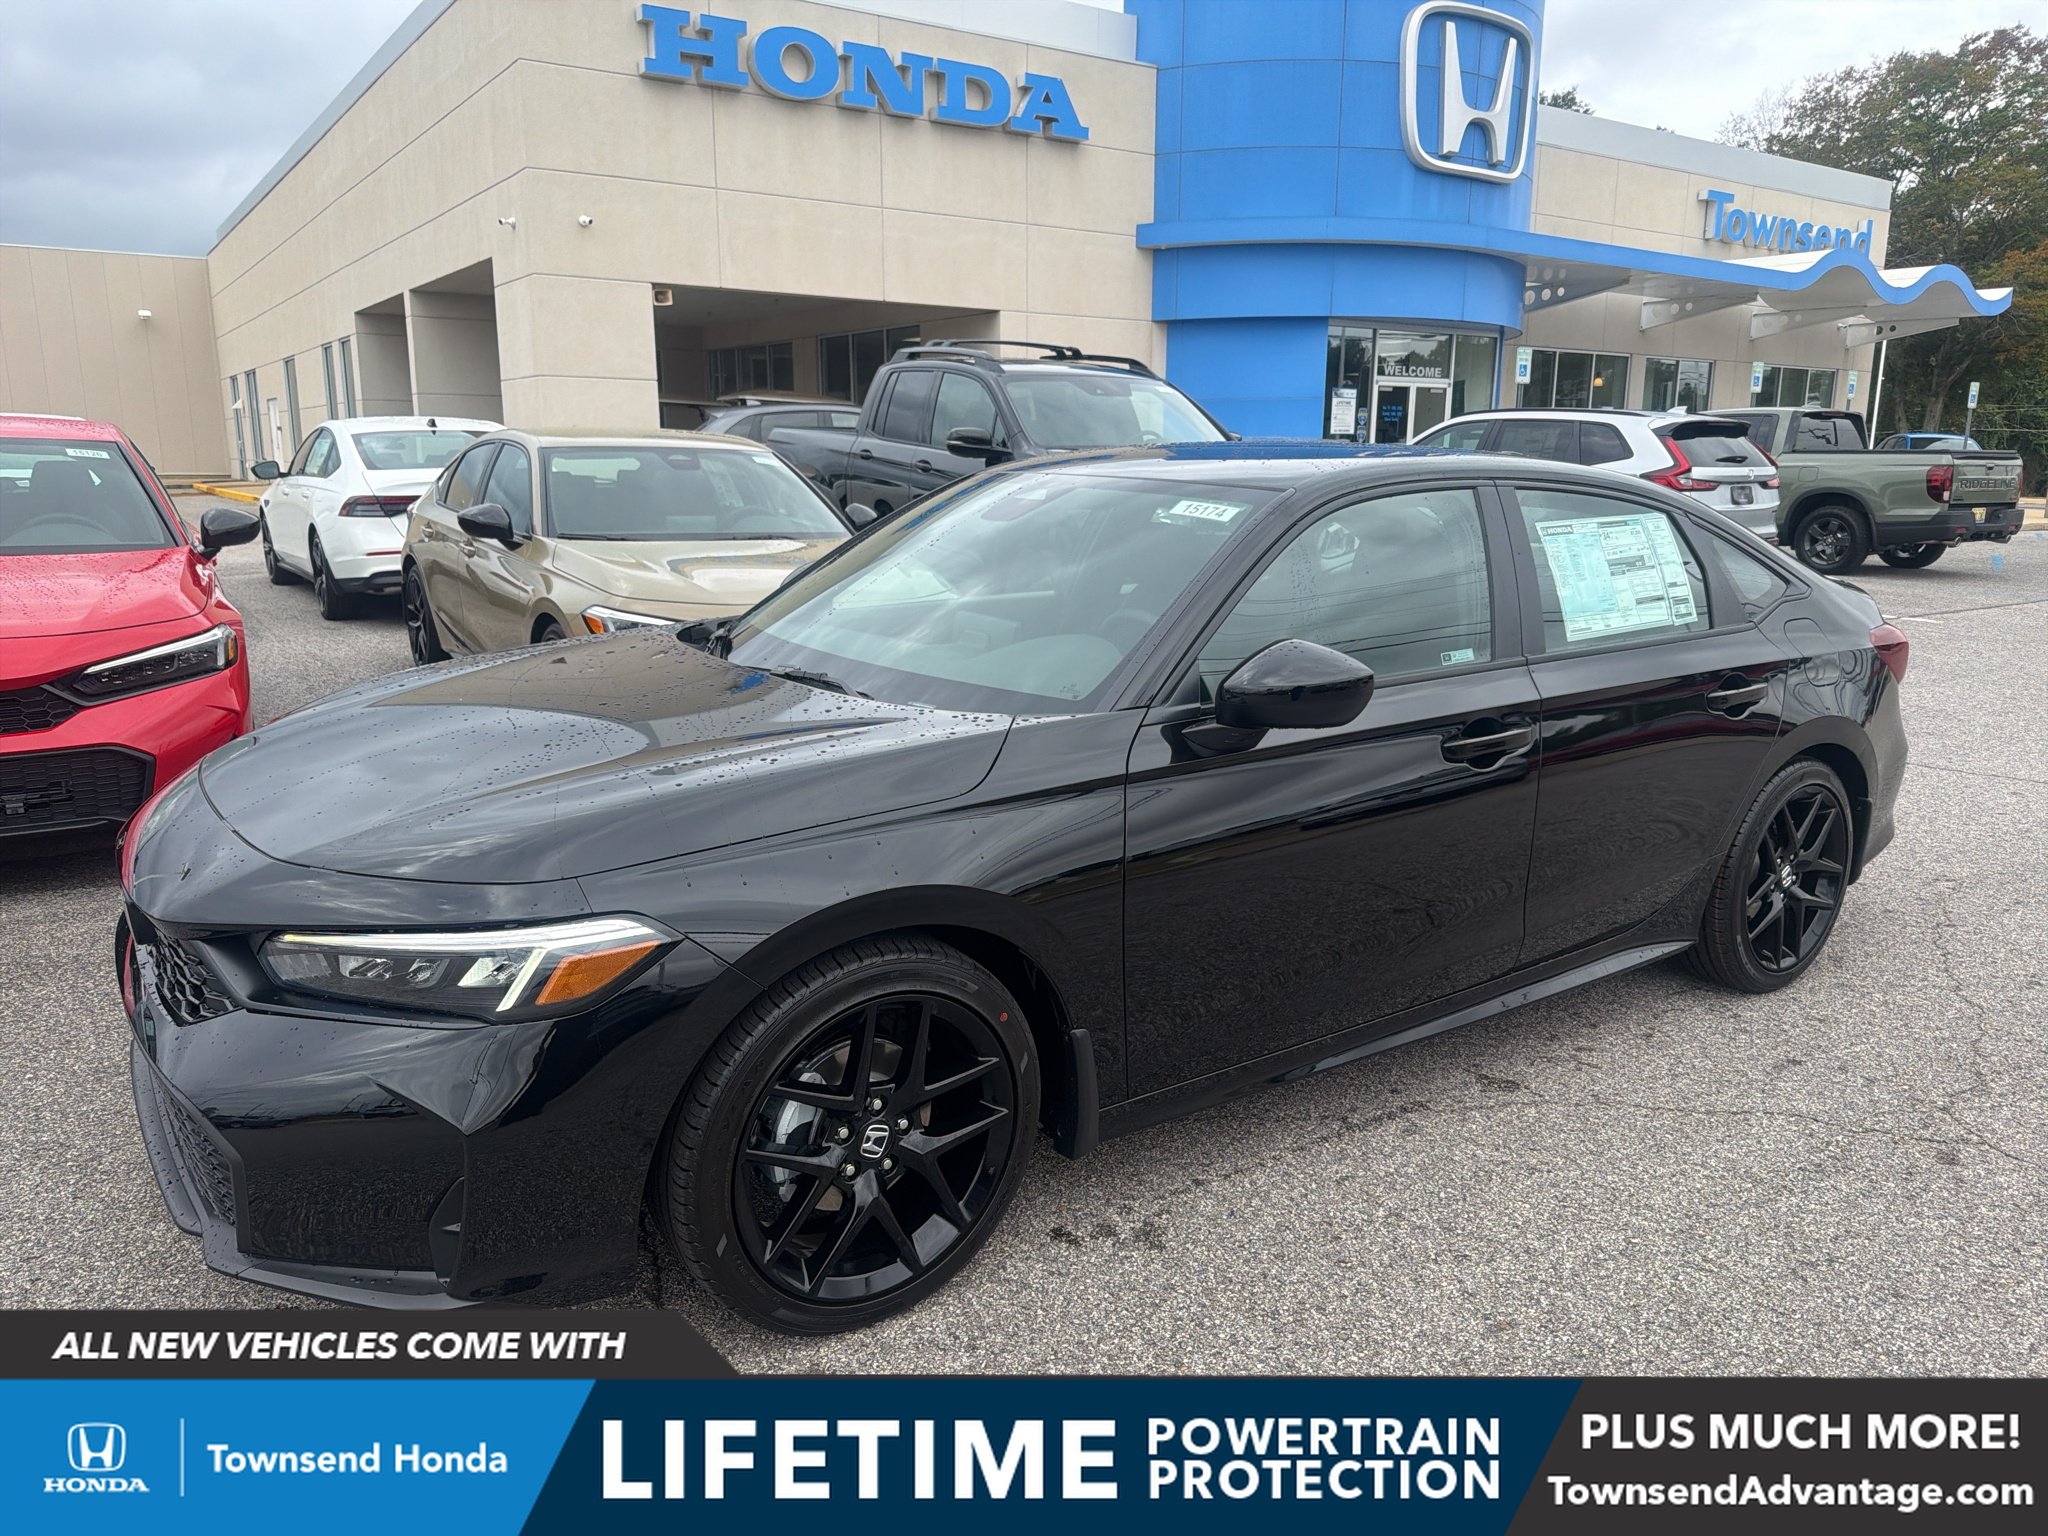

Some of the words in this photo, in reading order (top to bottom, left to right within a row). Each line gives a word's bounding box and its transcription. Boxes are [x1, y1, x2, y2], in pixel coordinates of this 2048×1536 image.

[638, 3, 1090, 142] HONDA
[1698, 188, 1873, 253] Townsend
[1384, 365, 1442, 378] WELCOME
[1960, 479, 2016, 489] RIDGELINE
[1182, 503, 1228, 518] 15174
[1547, 526, 1573, 536] HONDA
